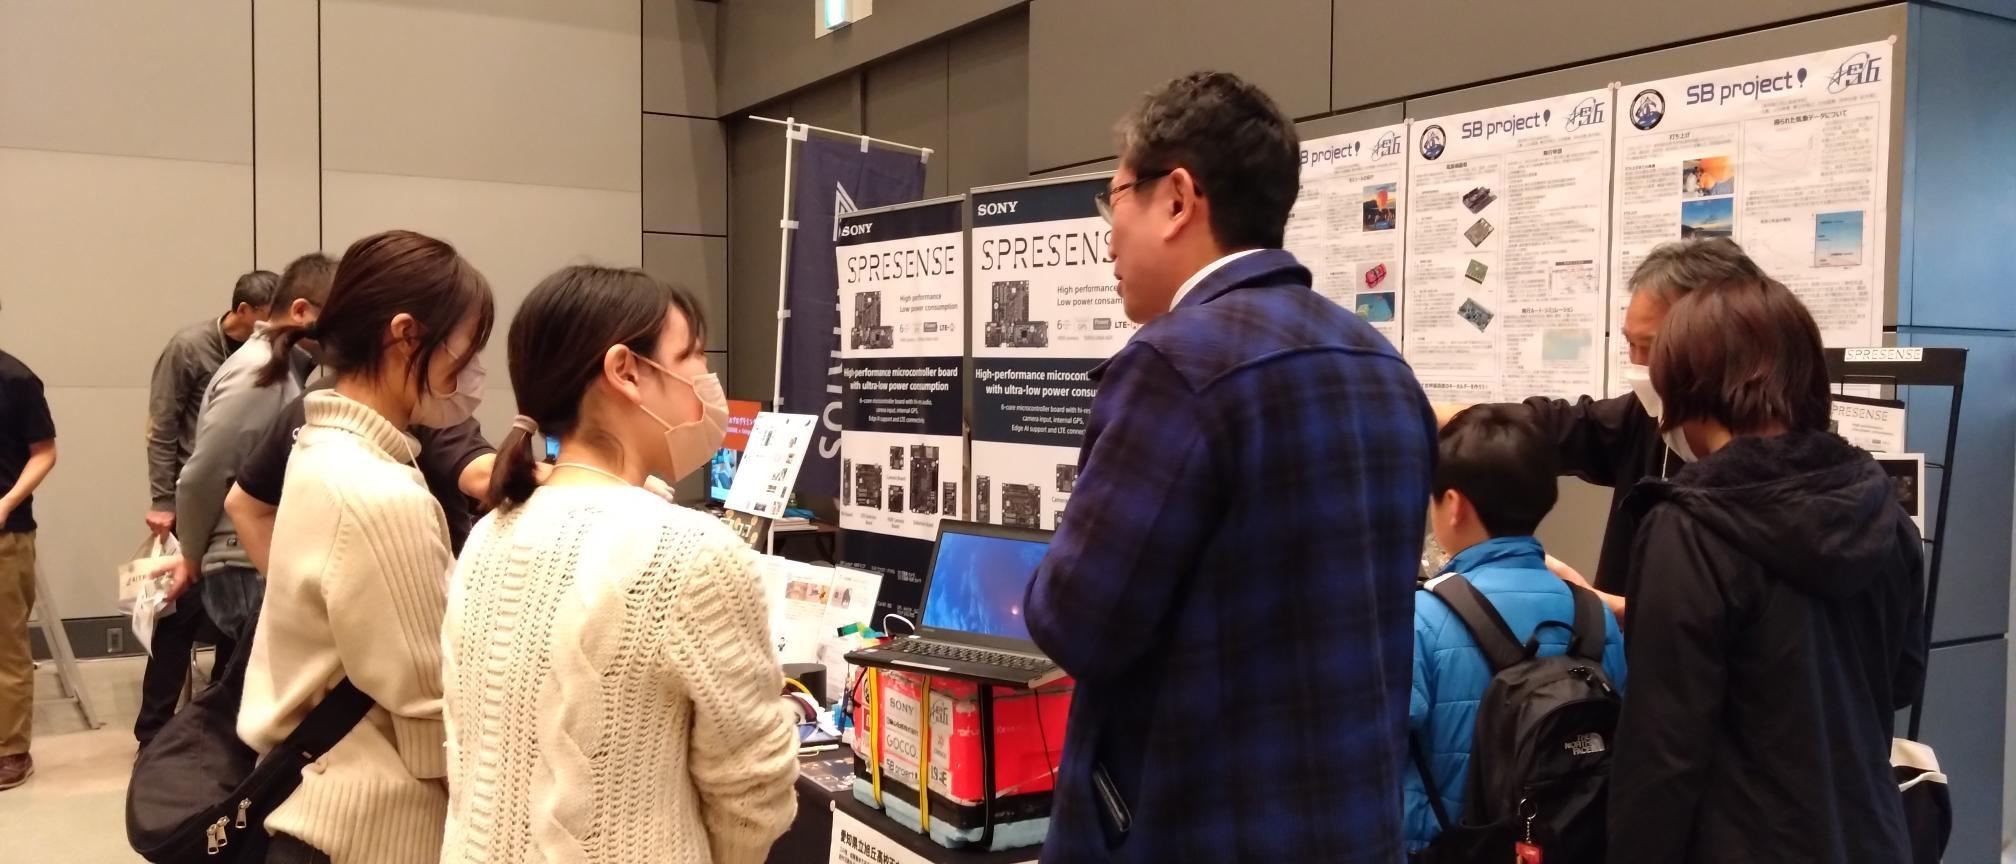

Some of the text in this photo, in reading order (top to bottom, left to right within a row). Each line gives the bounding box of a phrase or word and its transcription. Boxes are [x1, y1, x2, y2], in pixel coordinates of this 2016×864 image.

[1686, 82, 1714, 105] SB
[1461, 120, 1483, 140] SB
[978, 200, 1018, 216] SONY
[841, 222, 873, 237] SONY
[981, 230, 1117, 271] SPRESENS
[847, 245, 955, 284] SPRESENSE
[1057, 283, 1120, 295] High performance
[1073, 298, 1093, 308] power
[1846, 348, 1923, 360] SPRESENSE
[892, 366, 937, 377] microcontroller
[938, 366, 958, 377] board
[975, 368, 1089, 381] High-performance microcont
[889, 382, 909, 392] power
[910, 381, 949, 393] consumption
[985, 384, 1097, 398] with ultra-low power consu
[1050, 405, 1065, 413] board
[1832, 404, 1889, 422] PRESENSE
[1011, 424, 1023, 432] Edge
[1058, 426, 1066, 434] LTE
[889, 697, 914, 716] SONY
[1564, 740, 1592, 749] NORTH
[1573, 747, 1592, 756] FACE
